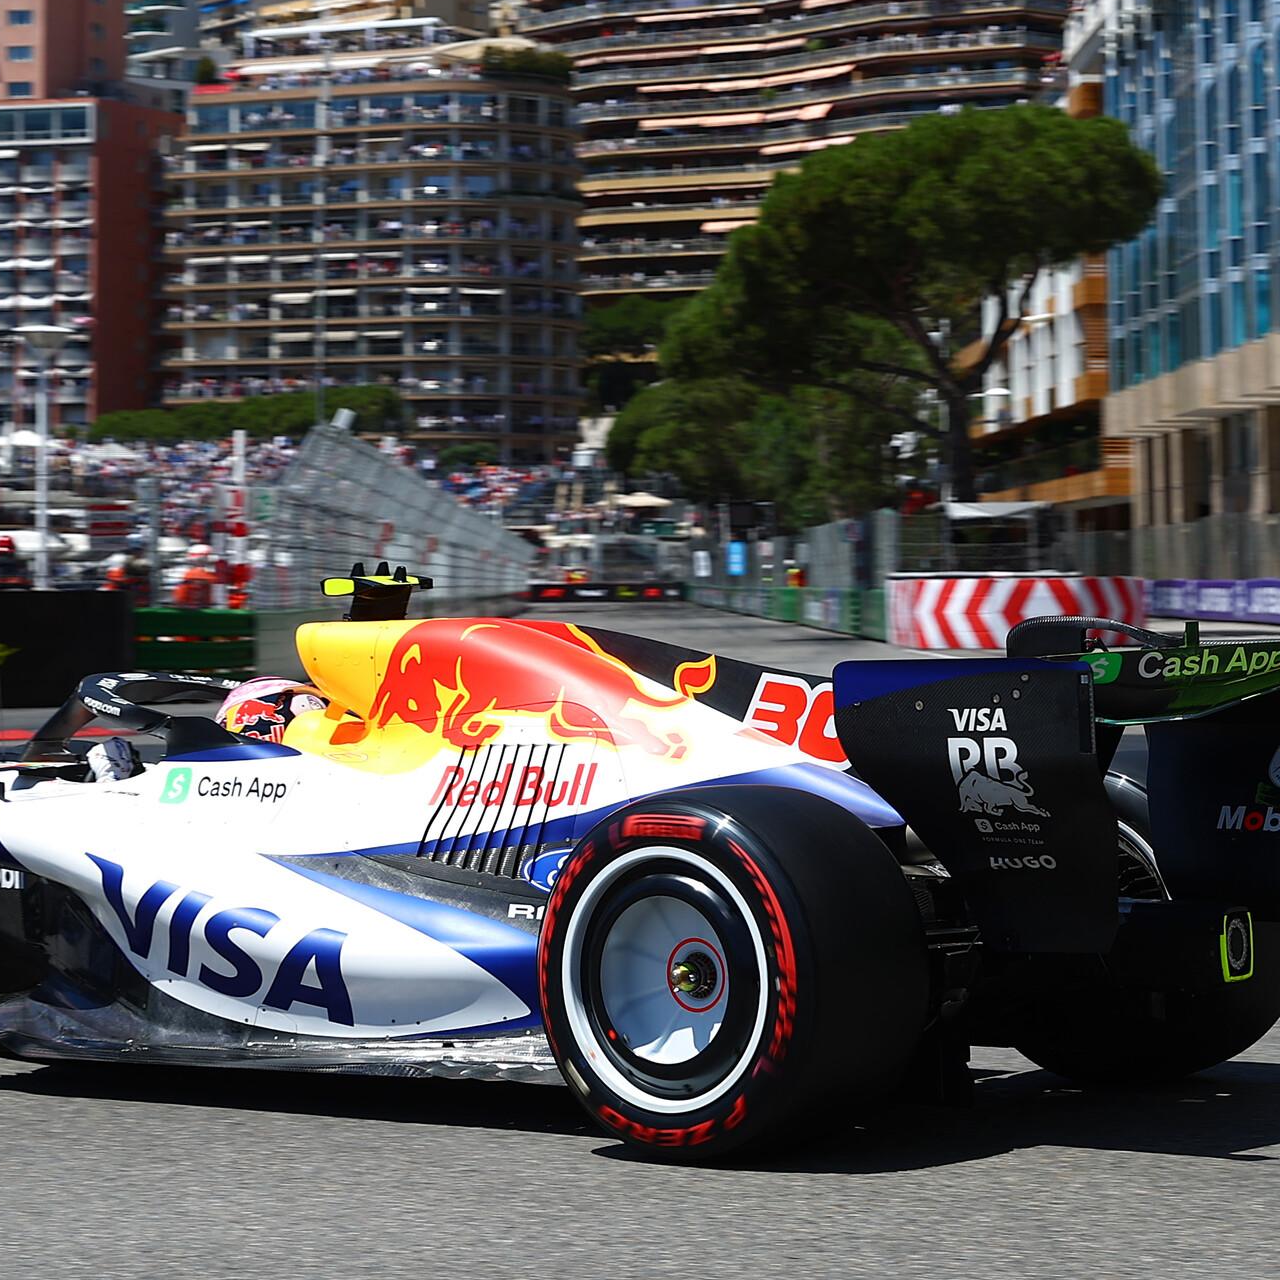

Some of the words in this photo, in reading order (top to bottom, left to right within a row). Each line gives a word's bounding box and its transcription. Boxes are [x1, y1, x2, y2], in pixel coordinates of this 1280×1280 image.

[1138, 649, 1219, 679] Cash
[947, 708, 1008, 732] VISA
[197, 776, 243, 797] Cash
[246, 776, 288, 803] App
[428, 763, 514, 807] Red
[512, 763, 599, 807] Bull
[994, 822, 1020, 831] Cash
[1021, 822, 1041, 833] App
[989, 855, 1057, 869] HUGO
[85, 852, 355, 1027] VISA
